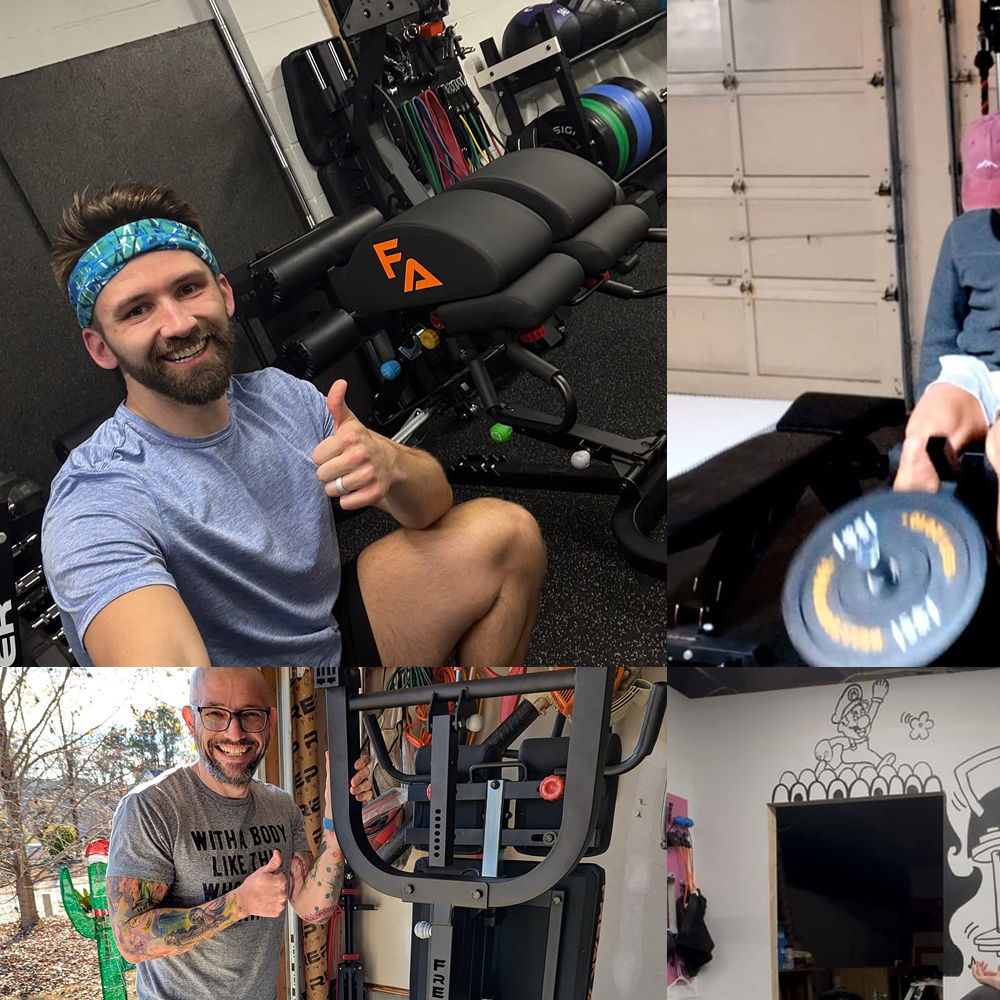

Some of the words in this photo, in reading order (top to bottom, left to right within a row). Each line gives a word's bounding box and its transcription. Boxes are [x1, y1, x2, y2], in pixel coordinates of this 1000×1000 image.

[373, 238, 443, 293] FA
[191, 829, 237, 851] WITH
[239, 829, 248, 849] A
[249, 824, 287, 846] BODY
[212, 855, 247, 877] LIKE
